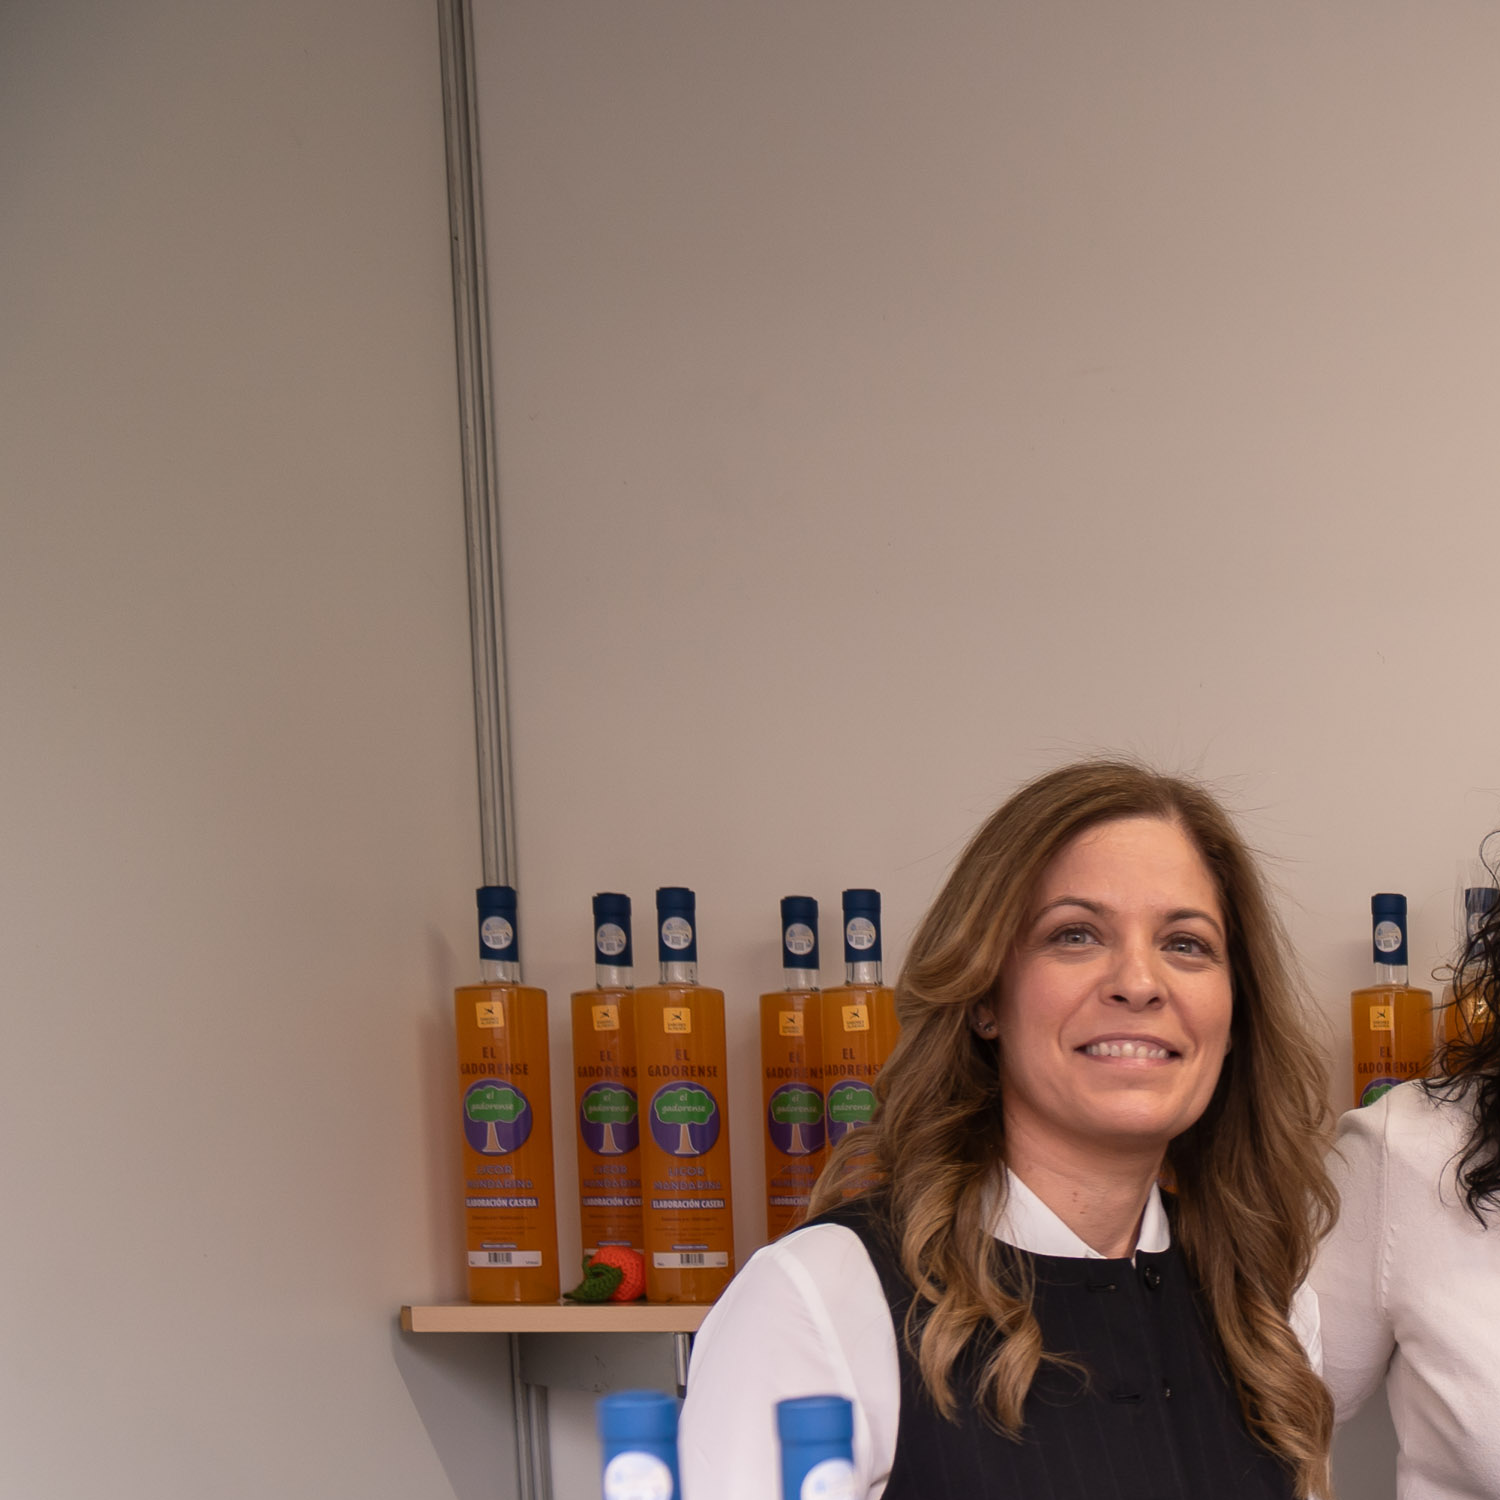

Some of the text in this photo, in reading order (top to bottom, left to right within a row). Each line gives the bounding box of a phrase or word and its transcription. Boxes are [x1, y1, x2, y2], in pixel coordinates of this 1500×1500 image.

[482, 1047, 496, 1059] EL
[676, 1048, 690, 1061] EL
[842, 1048, 856, 1060] EL
[1379, 1046, 1392, 1058] EL
[460, 1063, 529, 1076] GADORENSE
[578, 1066, 637, 1078] GADORENS
[648, 1065, 718, 1078] GADORENSE
[1358, 1061, 1420, 1074] GADORENSE
[661, 1103, 706, 1114] gadorense
[668, 1166, 705, 1177] LICOR
[653, 1199, 700, 1208] ELABORACIÓN
